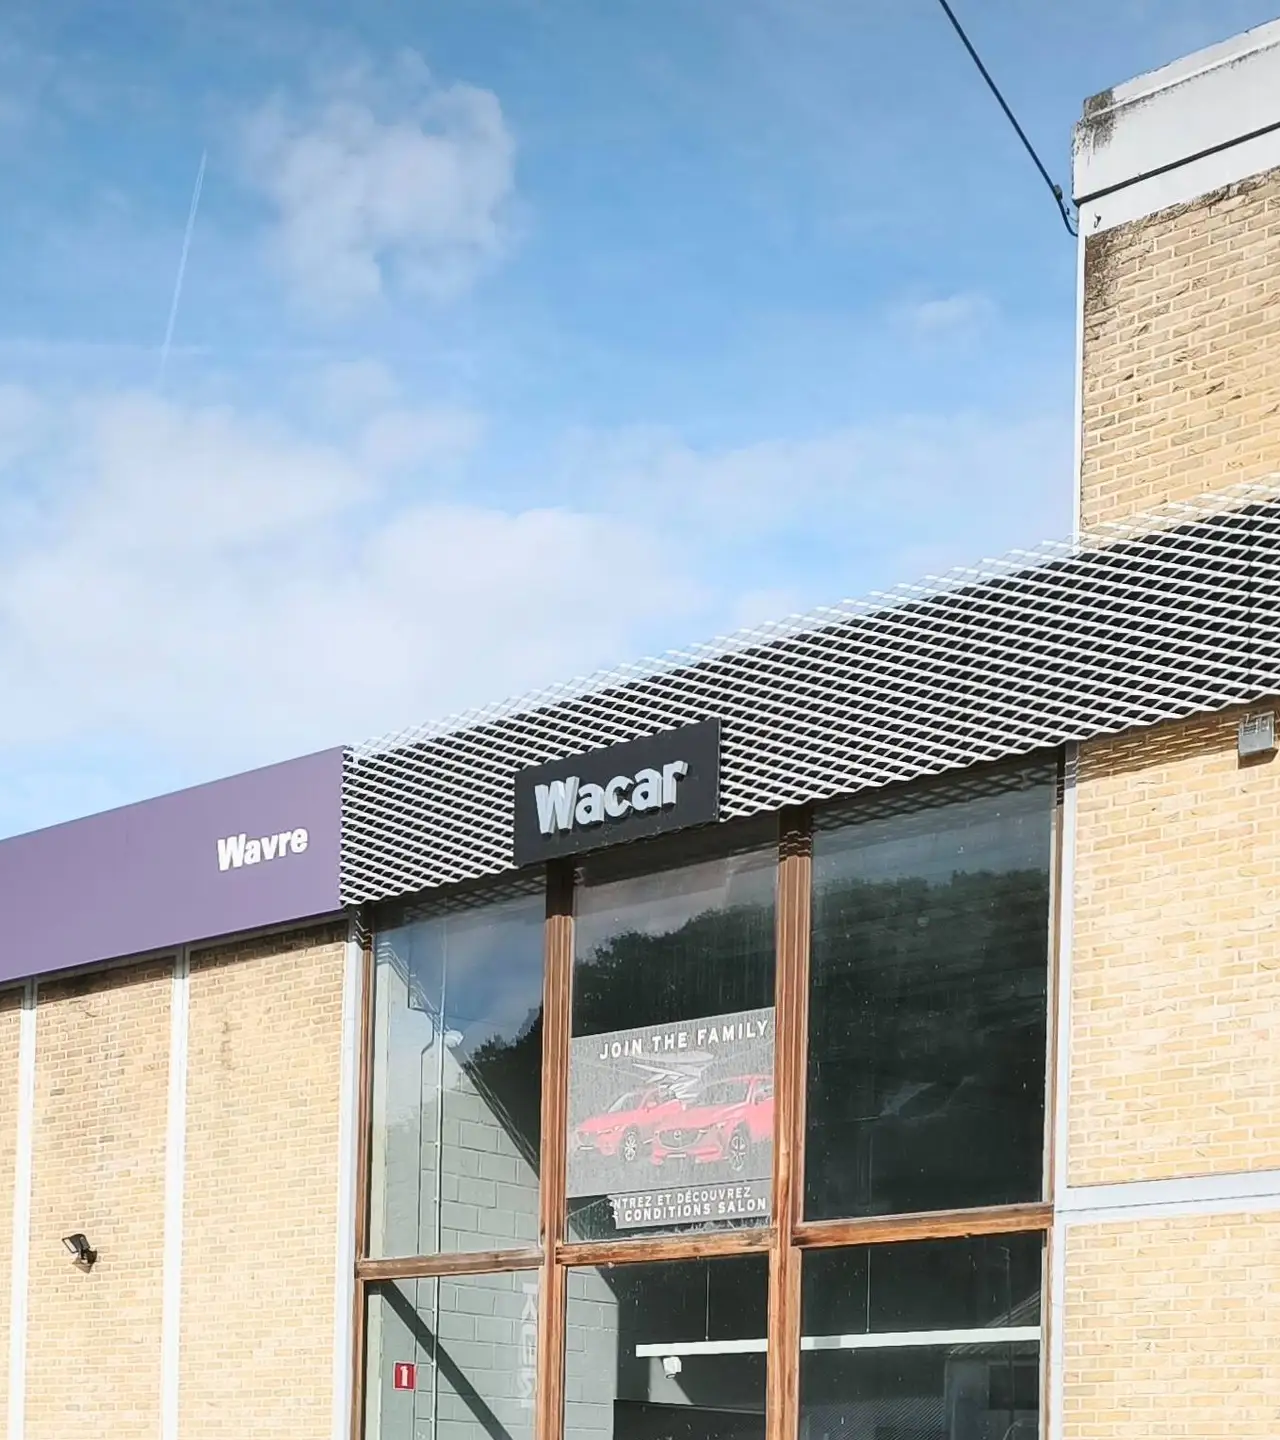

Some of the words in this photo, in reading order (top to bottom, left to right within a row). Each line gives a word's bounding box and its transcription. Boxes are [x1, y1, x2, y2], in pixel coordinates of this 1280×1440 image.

[534, 760, 689, 835] Wacar
[217, 828, 309, 872] Wavre
[599, 1038, 643, 1060] JOIN
[651, 1031, 688, 1053] THE
[697, 1019, 769, 1046] FAMILY
[610, 1195, 652, 1209] NTREZ
[657, 1194, 672, 1206] ET
[677, 1186, 751, 1203] DÉCOUVREZ
[624, 1203, 711, 1222] CONDITIONS
[718, 1197, 766, 1214] SALON
